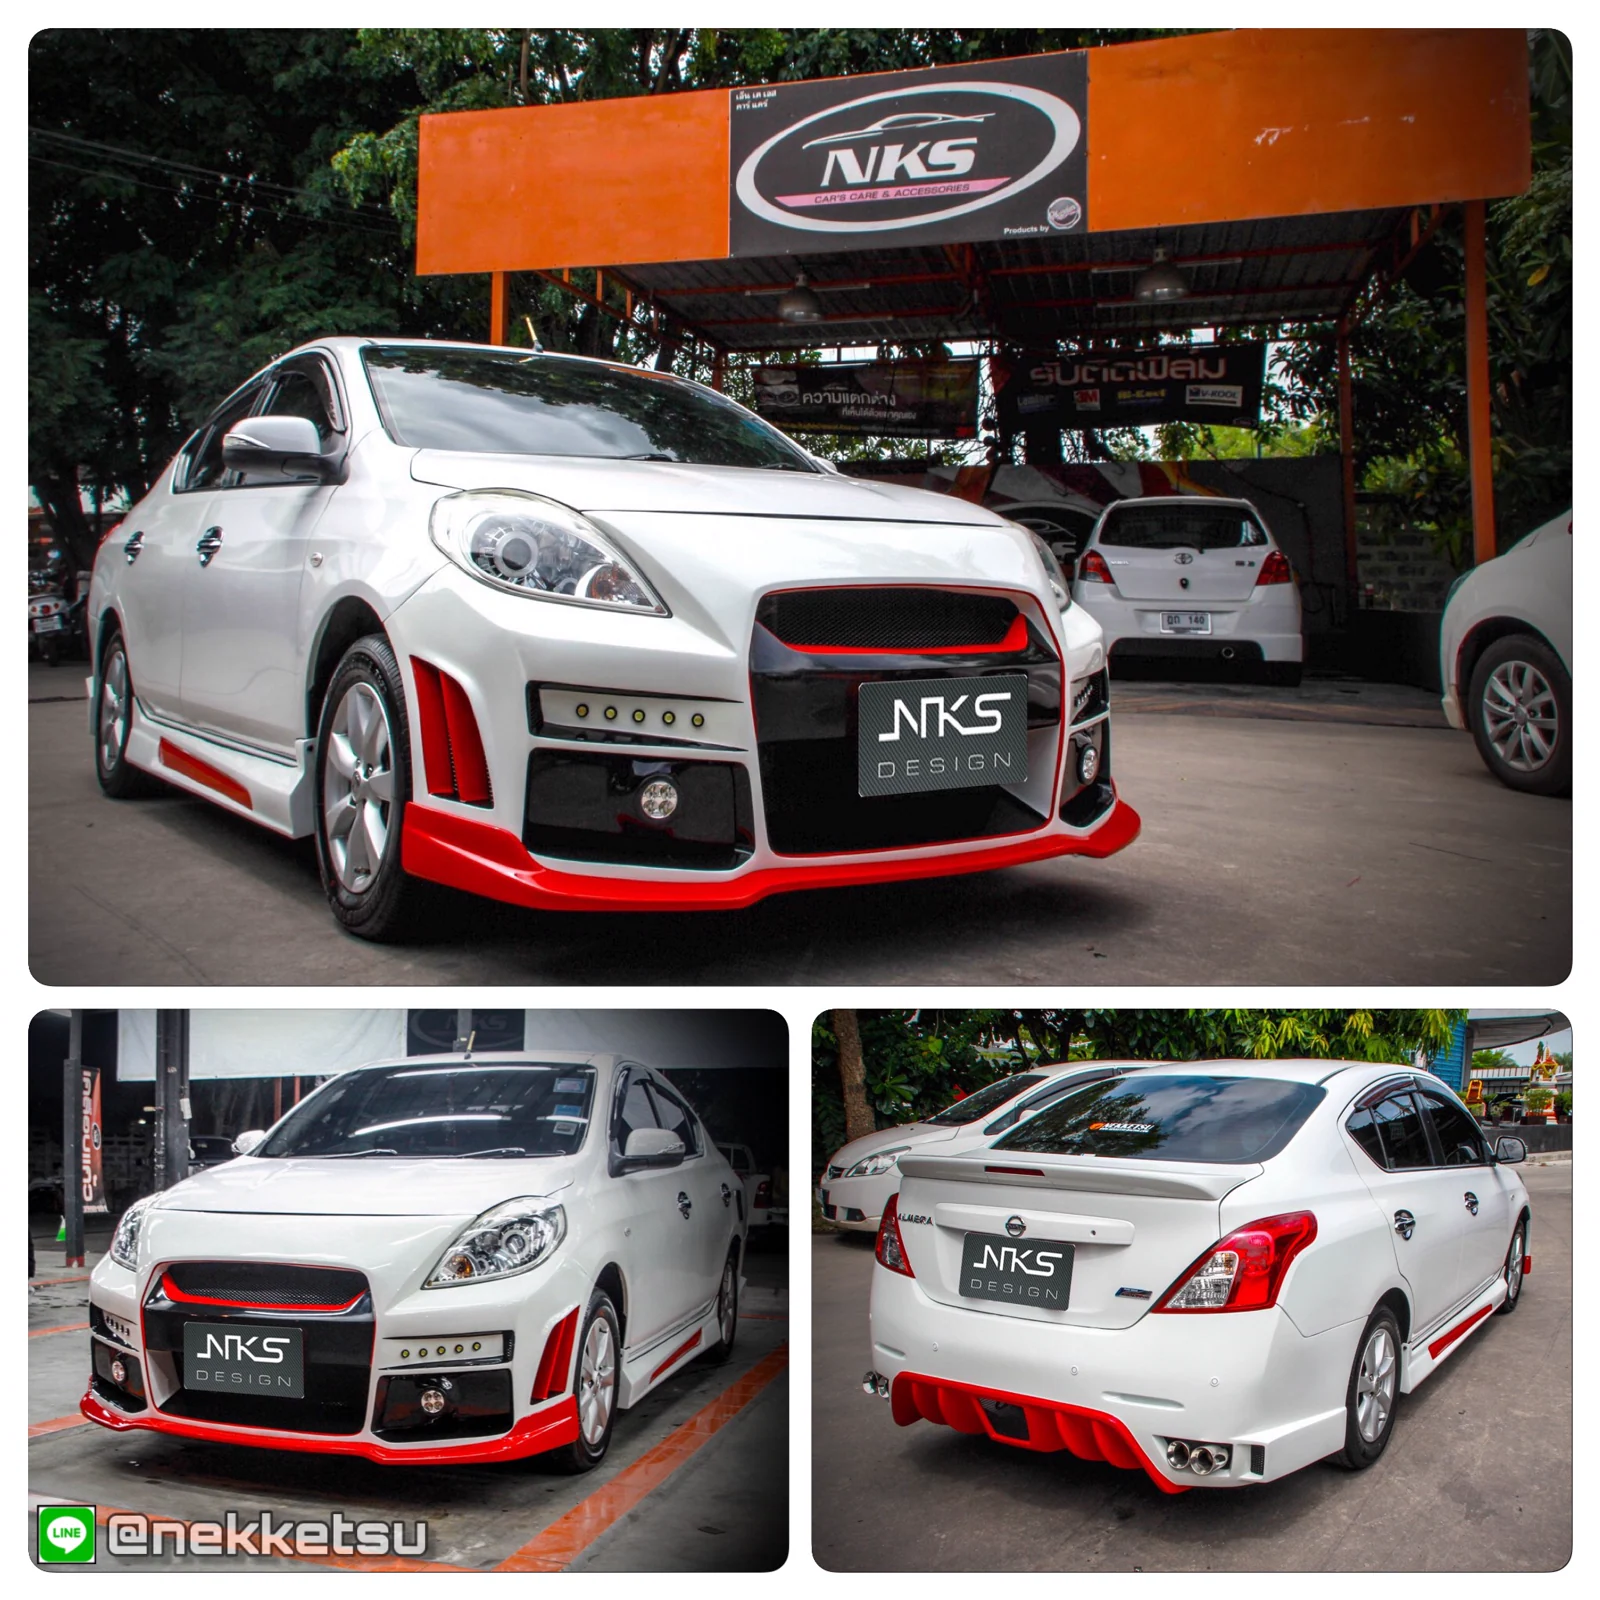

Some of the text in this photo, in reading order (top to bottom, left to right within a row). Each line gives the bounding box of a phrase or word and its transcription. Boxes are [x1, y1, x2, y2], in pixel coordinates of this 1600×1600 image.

[820, 137, 978, 187] NKS
[814, 183, 970, 204] CAR'S CARE & ACCESSORIES
[1003, 224, 1050, 235] Products by
[1076, 389, 1098, 402] 3M
[1200, 389, 1239, 399] V-KOOL
[1188, 616, 1205, 625] 140
